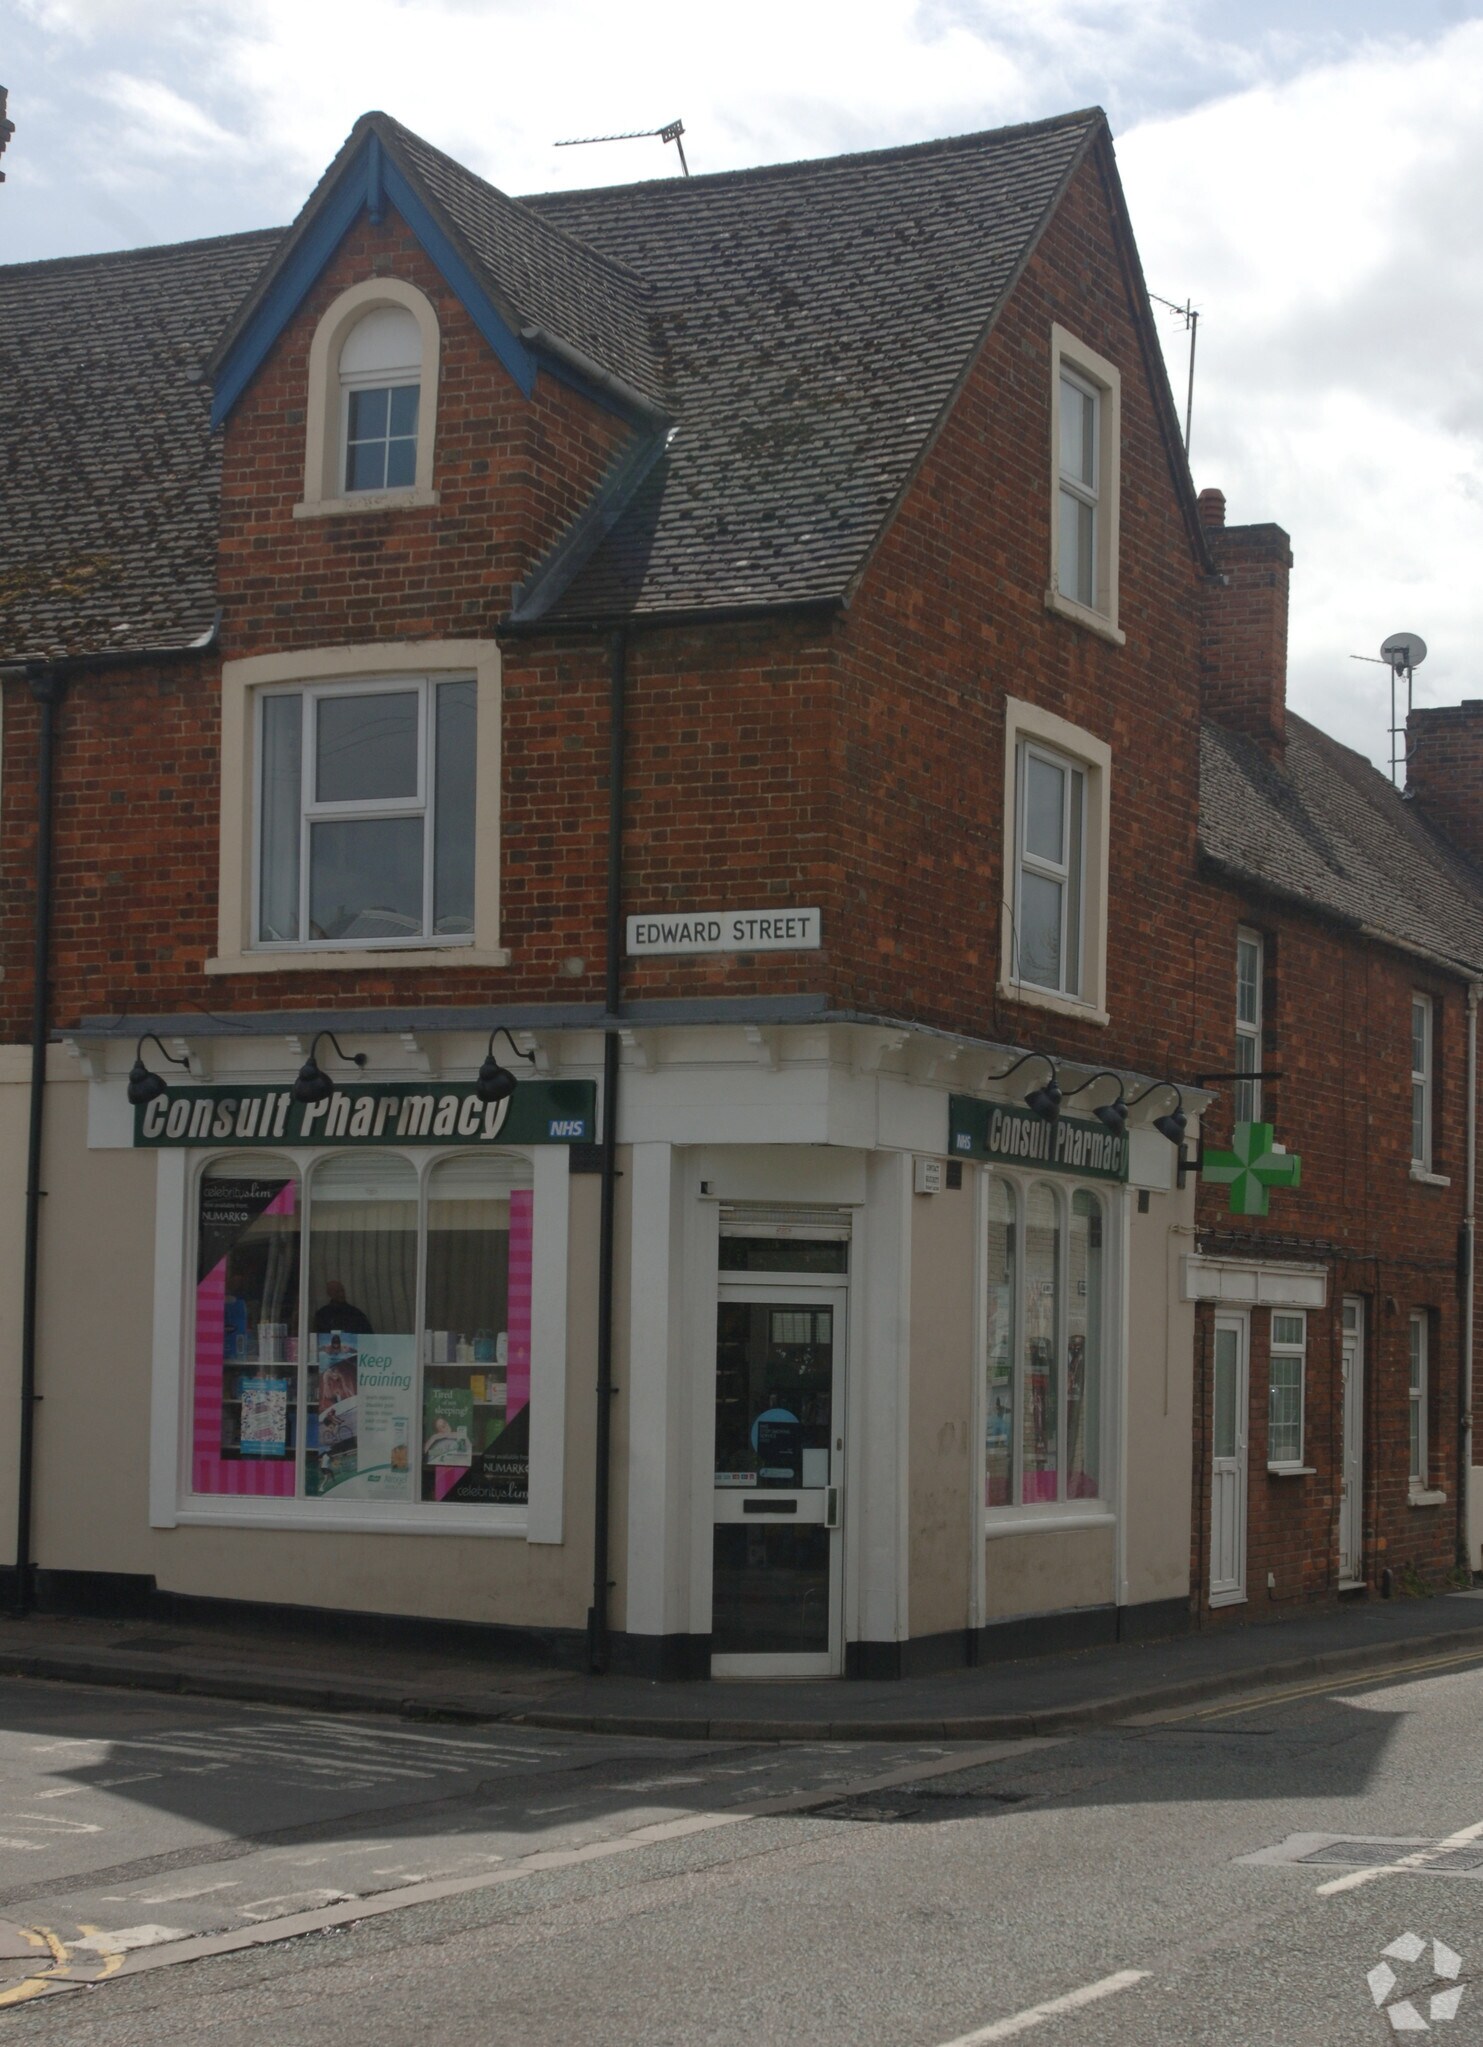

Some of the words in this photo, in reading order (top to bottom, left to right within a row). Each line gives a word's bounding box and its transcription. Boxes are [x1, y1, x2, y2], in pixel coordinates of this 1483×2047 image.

[636, 920, 721, 944] EDWARD
[733, 917, 811, 941] STREET
[141, 1091, 292, 1139] Consult
[301, 1091, 512, 1140] Pharmacy
[549, 1120, 585, 1137] NHS
[989, 1108, 1052, 1161] Consult
[956, 1133, 972, 1150] NHS
[202, 1212, 242, 1222] NUMARK
[358, 1353, 392, 1371] Keep
[359, 1372, 412, 1391] training
[483, 1463, 526, 1474] NUMARK
